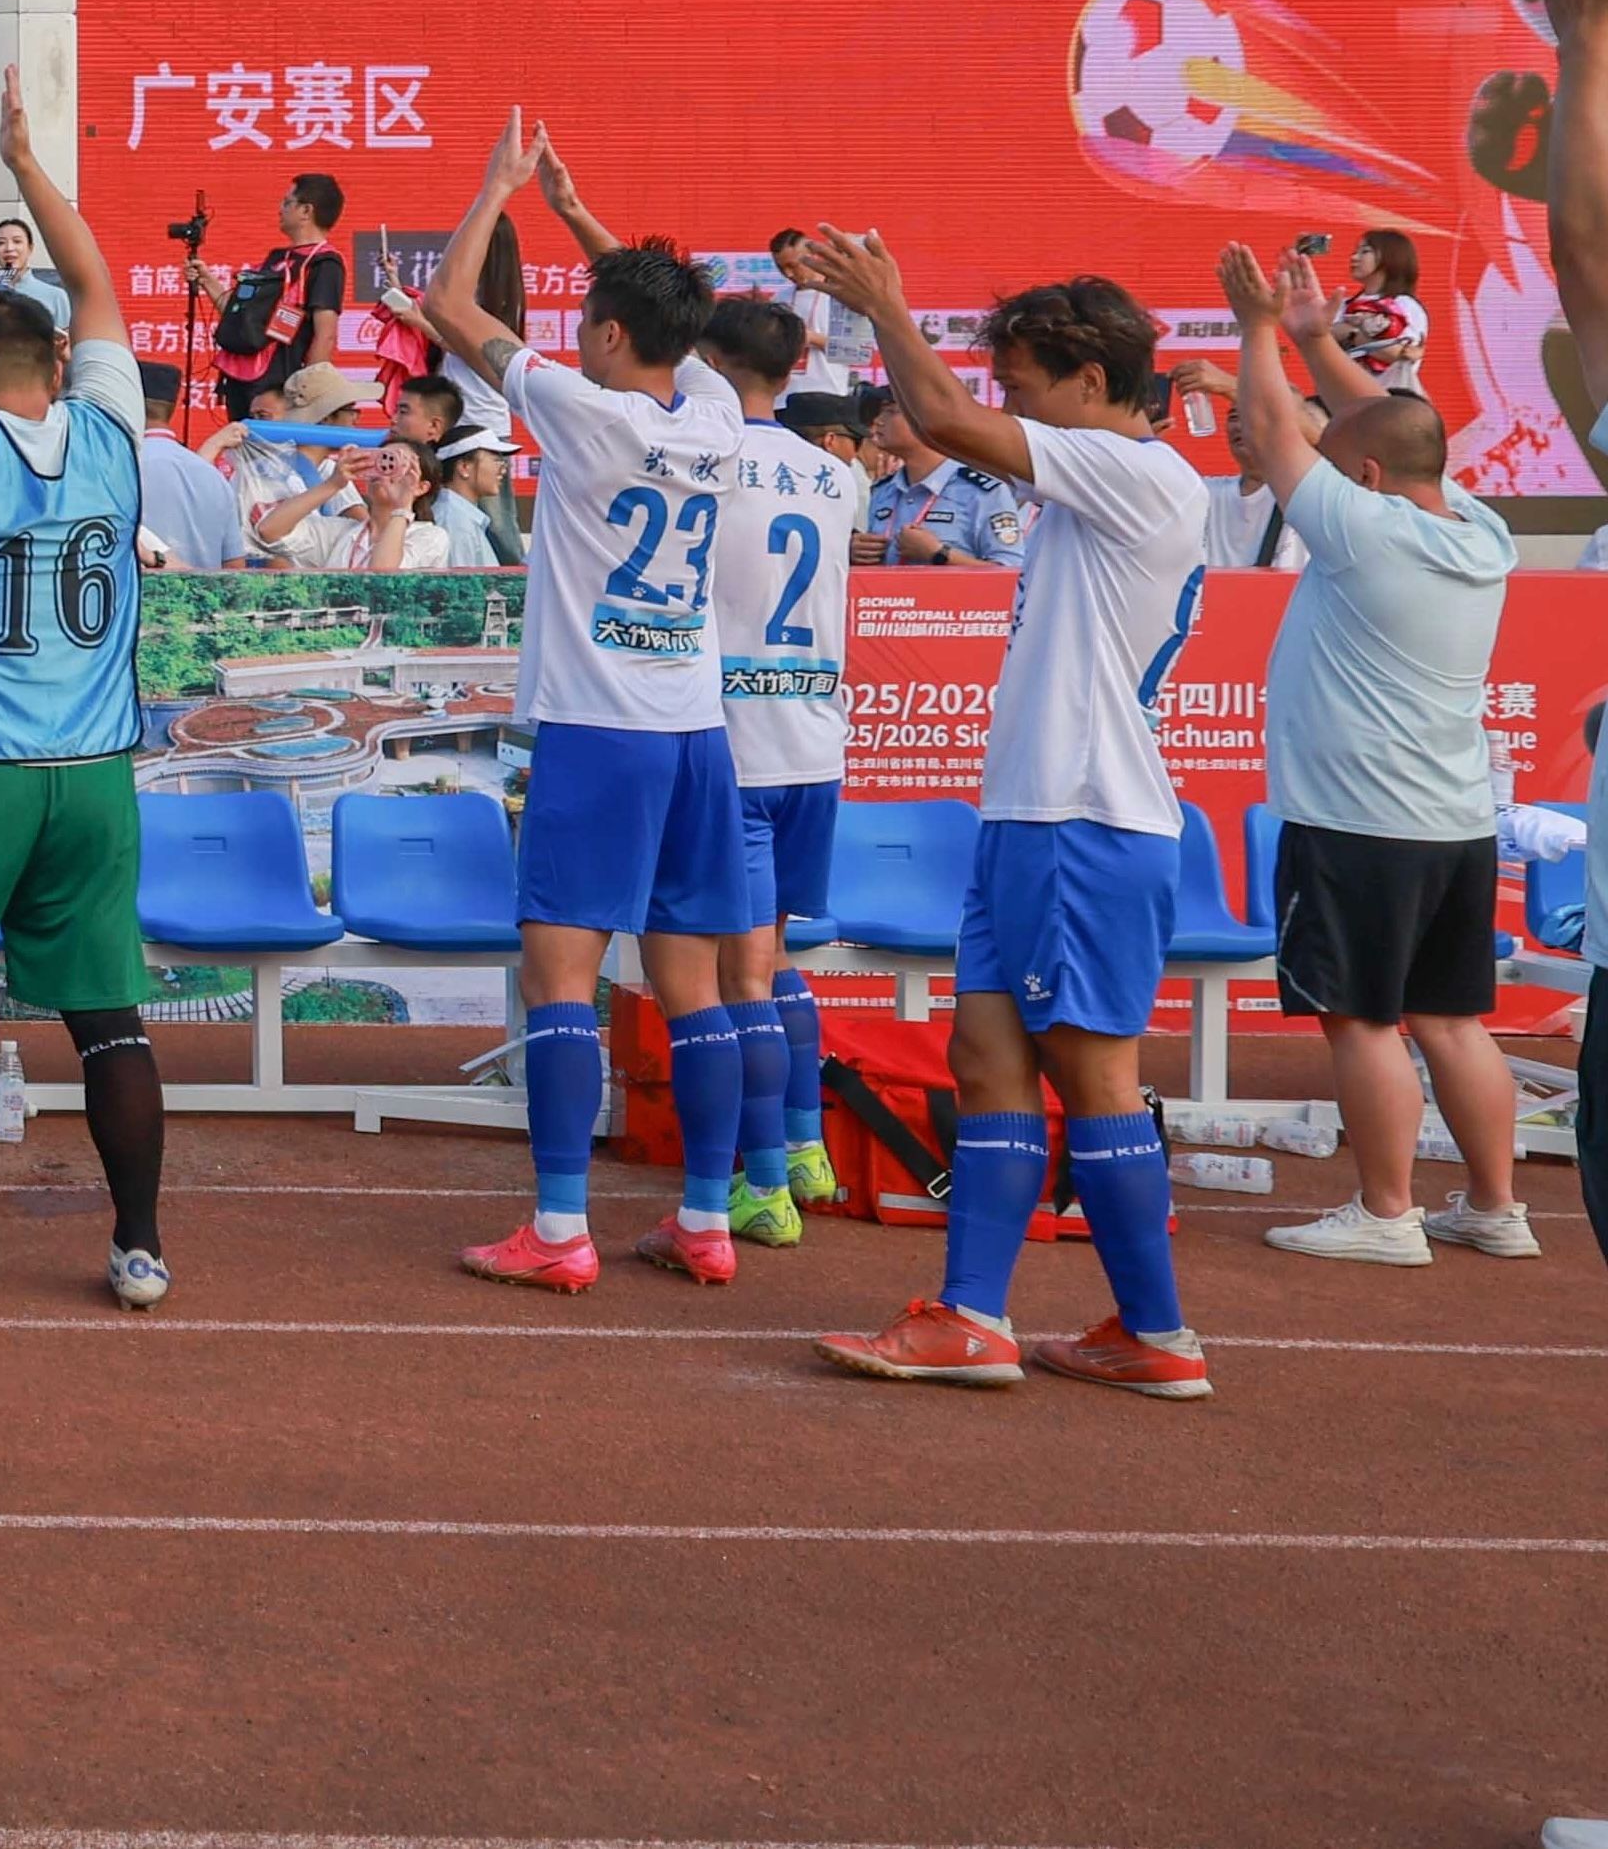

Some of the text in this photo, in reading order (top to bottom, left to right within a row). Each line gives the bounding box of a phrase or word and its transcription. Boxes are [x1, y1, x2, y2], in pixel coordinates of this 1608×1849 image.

[126, 62, 434, 151] 广安赛区
[606, 486, 719, 611] 23
[765, 513, 822, 648] 2
[857, 597, 916, 608] SICHUAN
[857, 610, 1009, 621] CITY FOOTBALL LEAGUE
[724, 670, 838, 696] 大竹肉丁面
